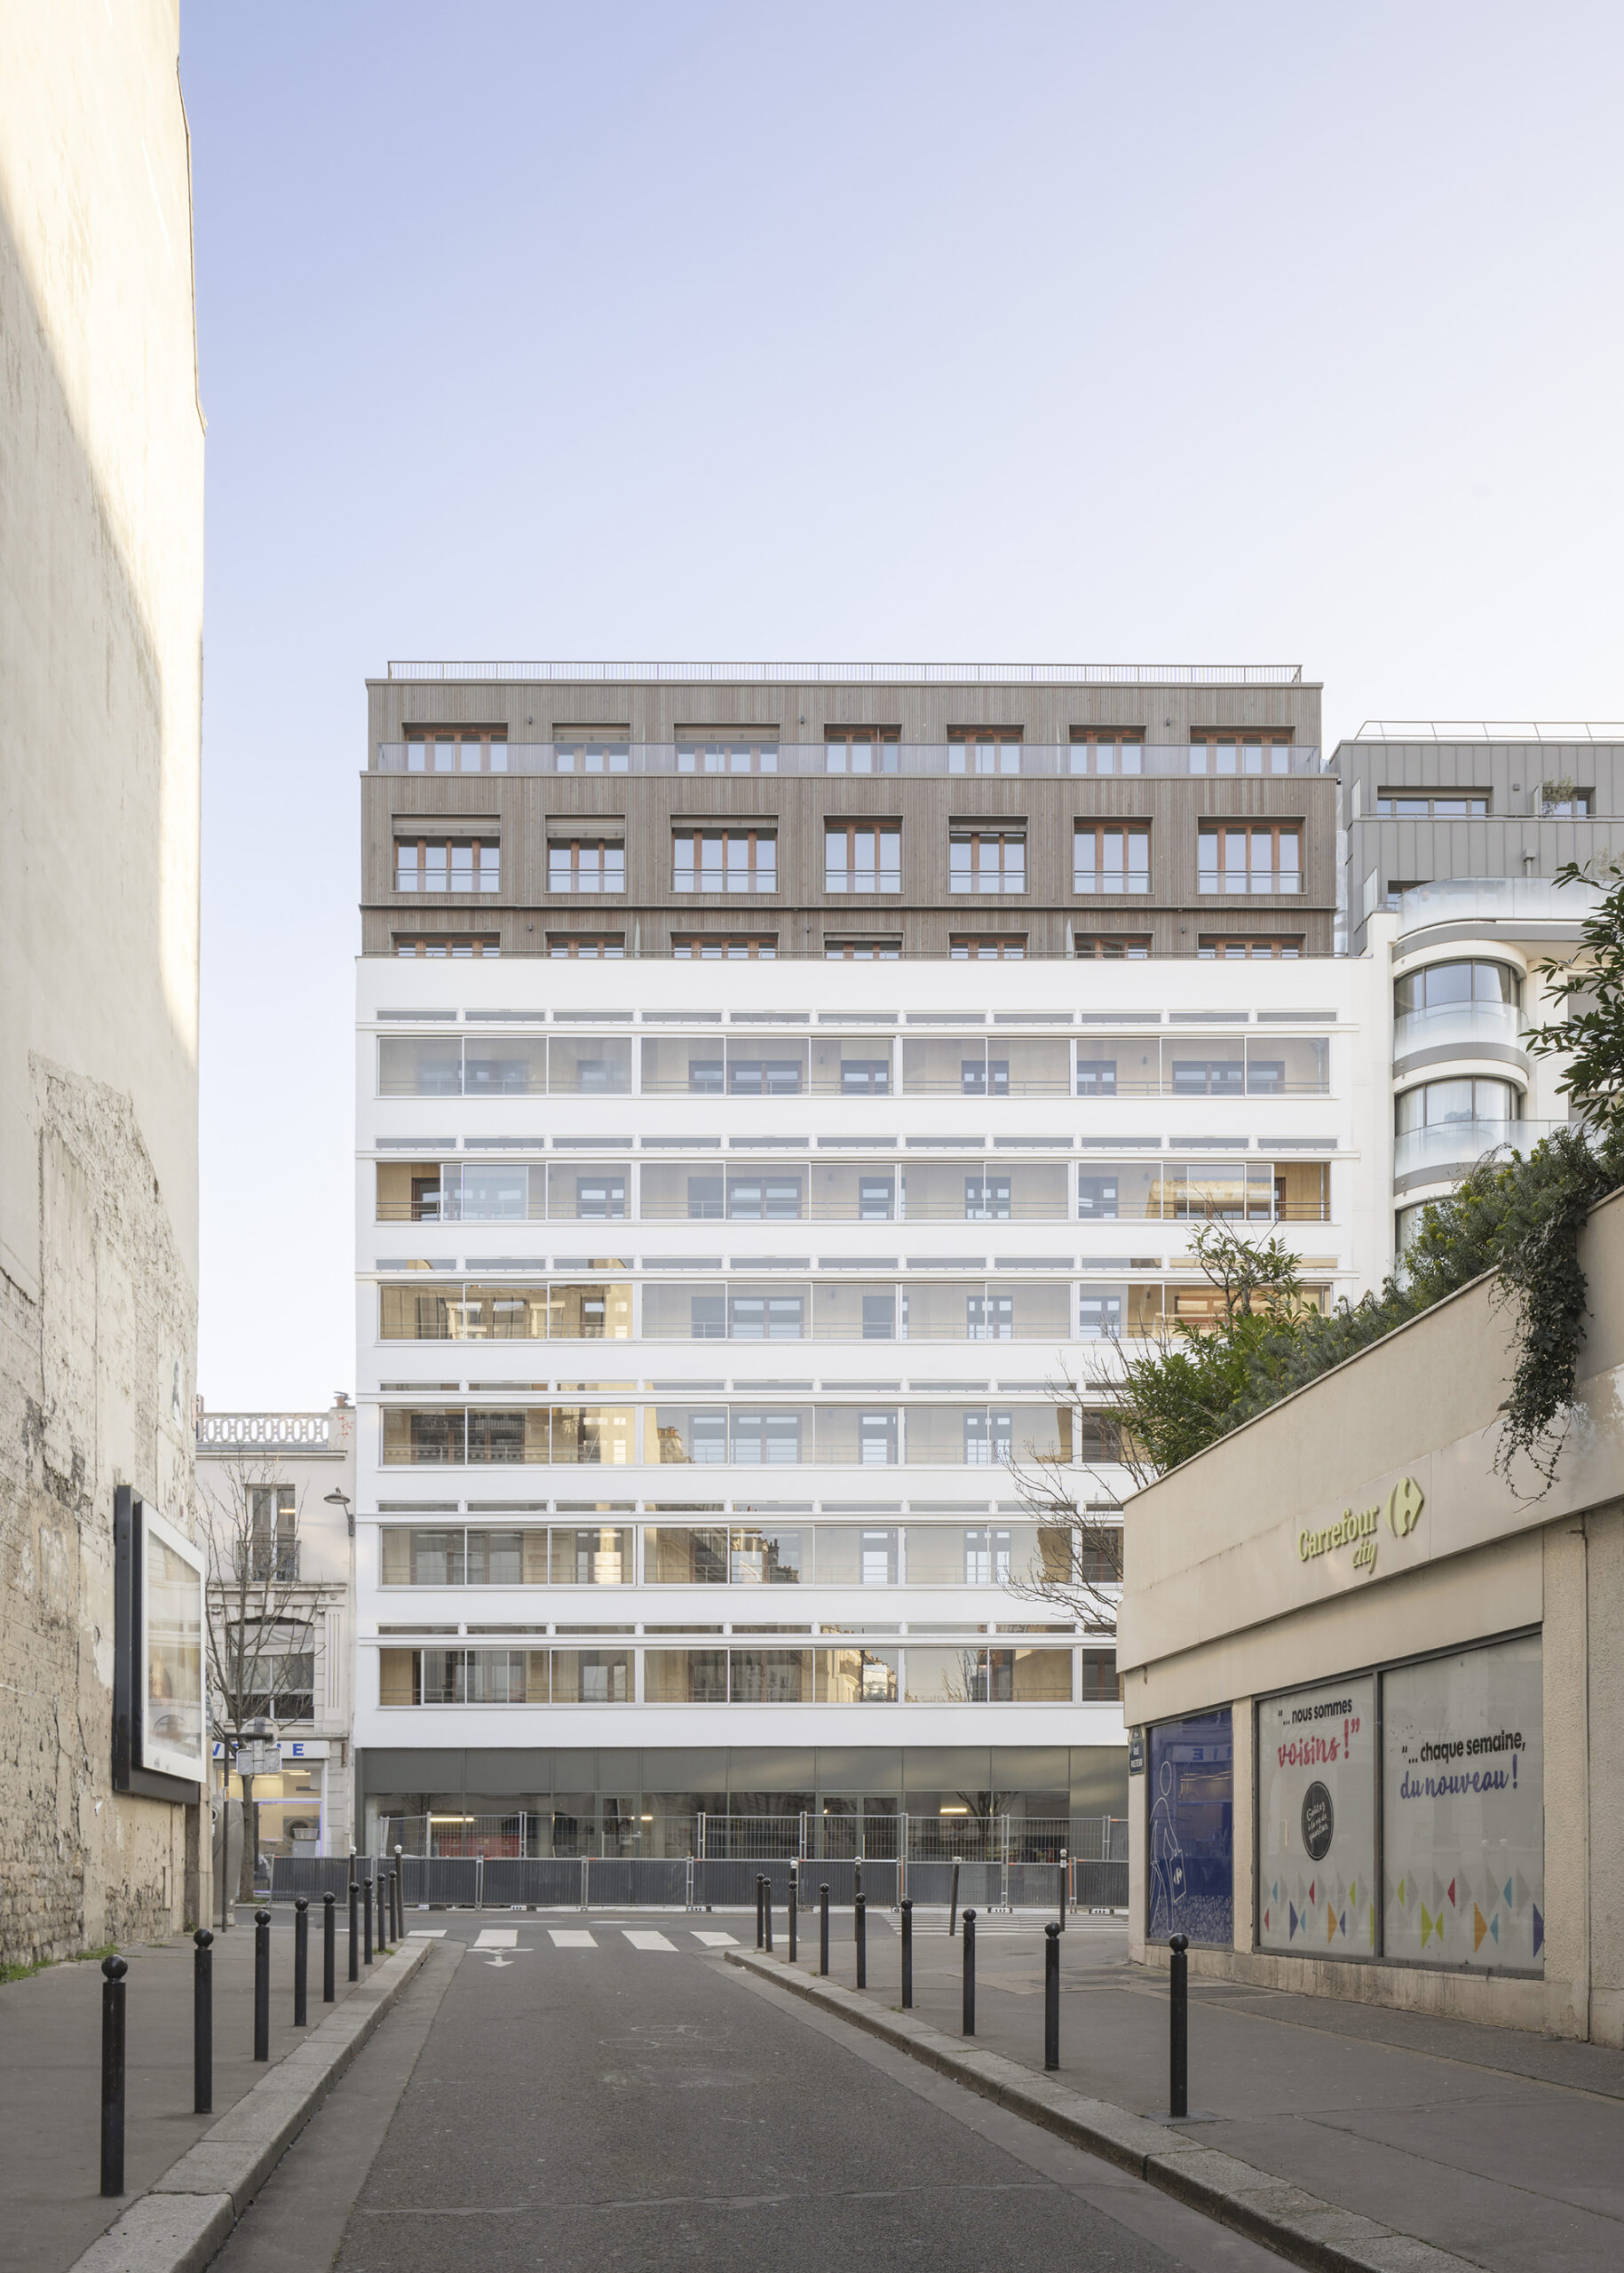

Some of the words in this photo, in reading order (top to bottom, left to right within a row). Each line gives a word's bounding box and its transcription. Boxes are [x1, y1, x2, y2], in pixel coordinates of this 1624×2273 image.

[1299, 1506, 1379, 1561] Carrefour
[1351, 1539, 1377, 1574] city
[1292, 1707, 1312, 1723] nous
[1314, 1699, 1352, 1719] sommes
[1421, 1742, 1464, 1763] chaque
[1467, 1730, 1525, 1755] semaine,
[1400, 1770, 1424, 1799] du
[1425, 1770, 1509, 1797] nouveau
